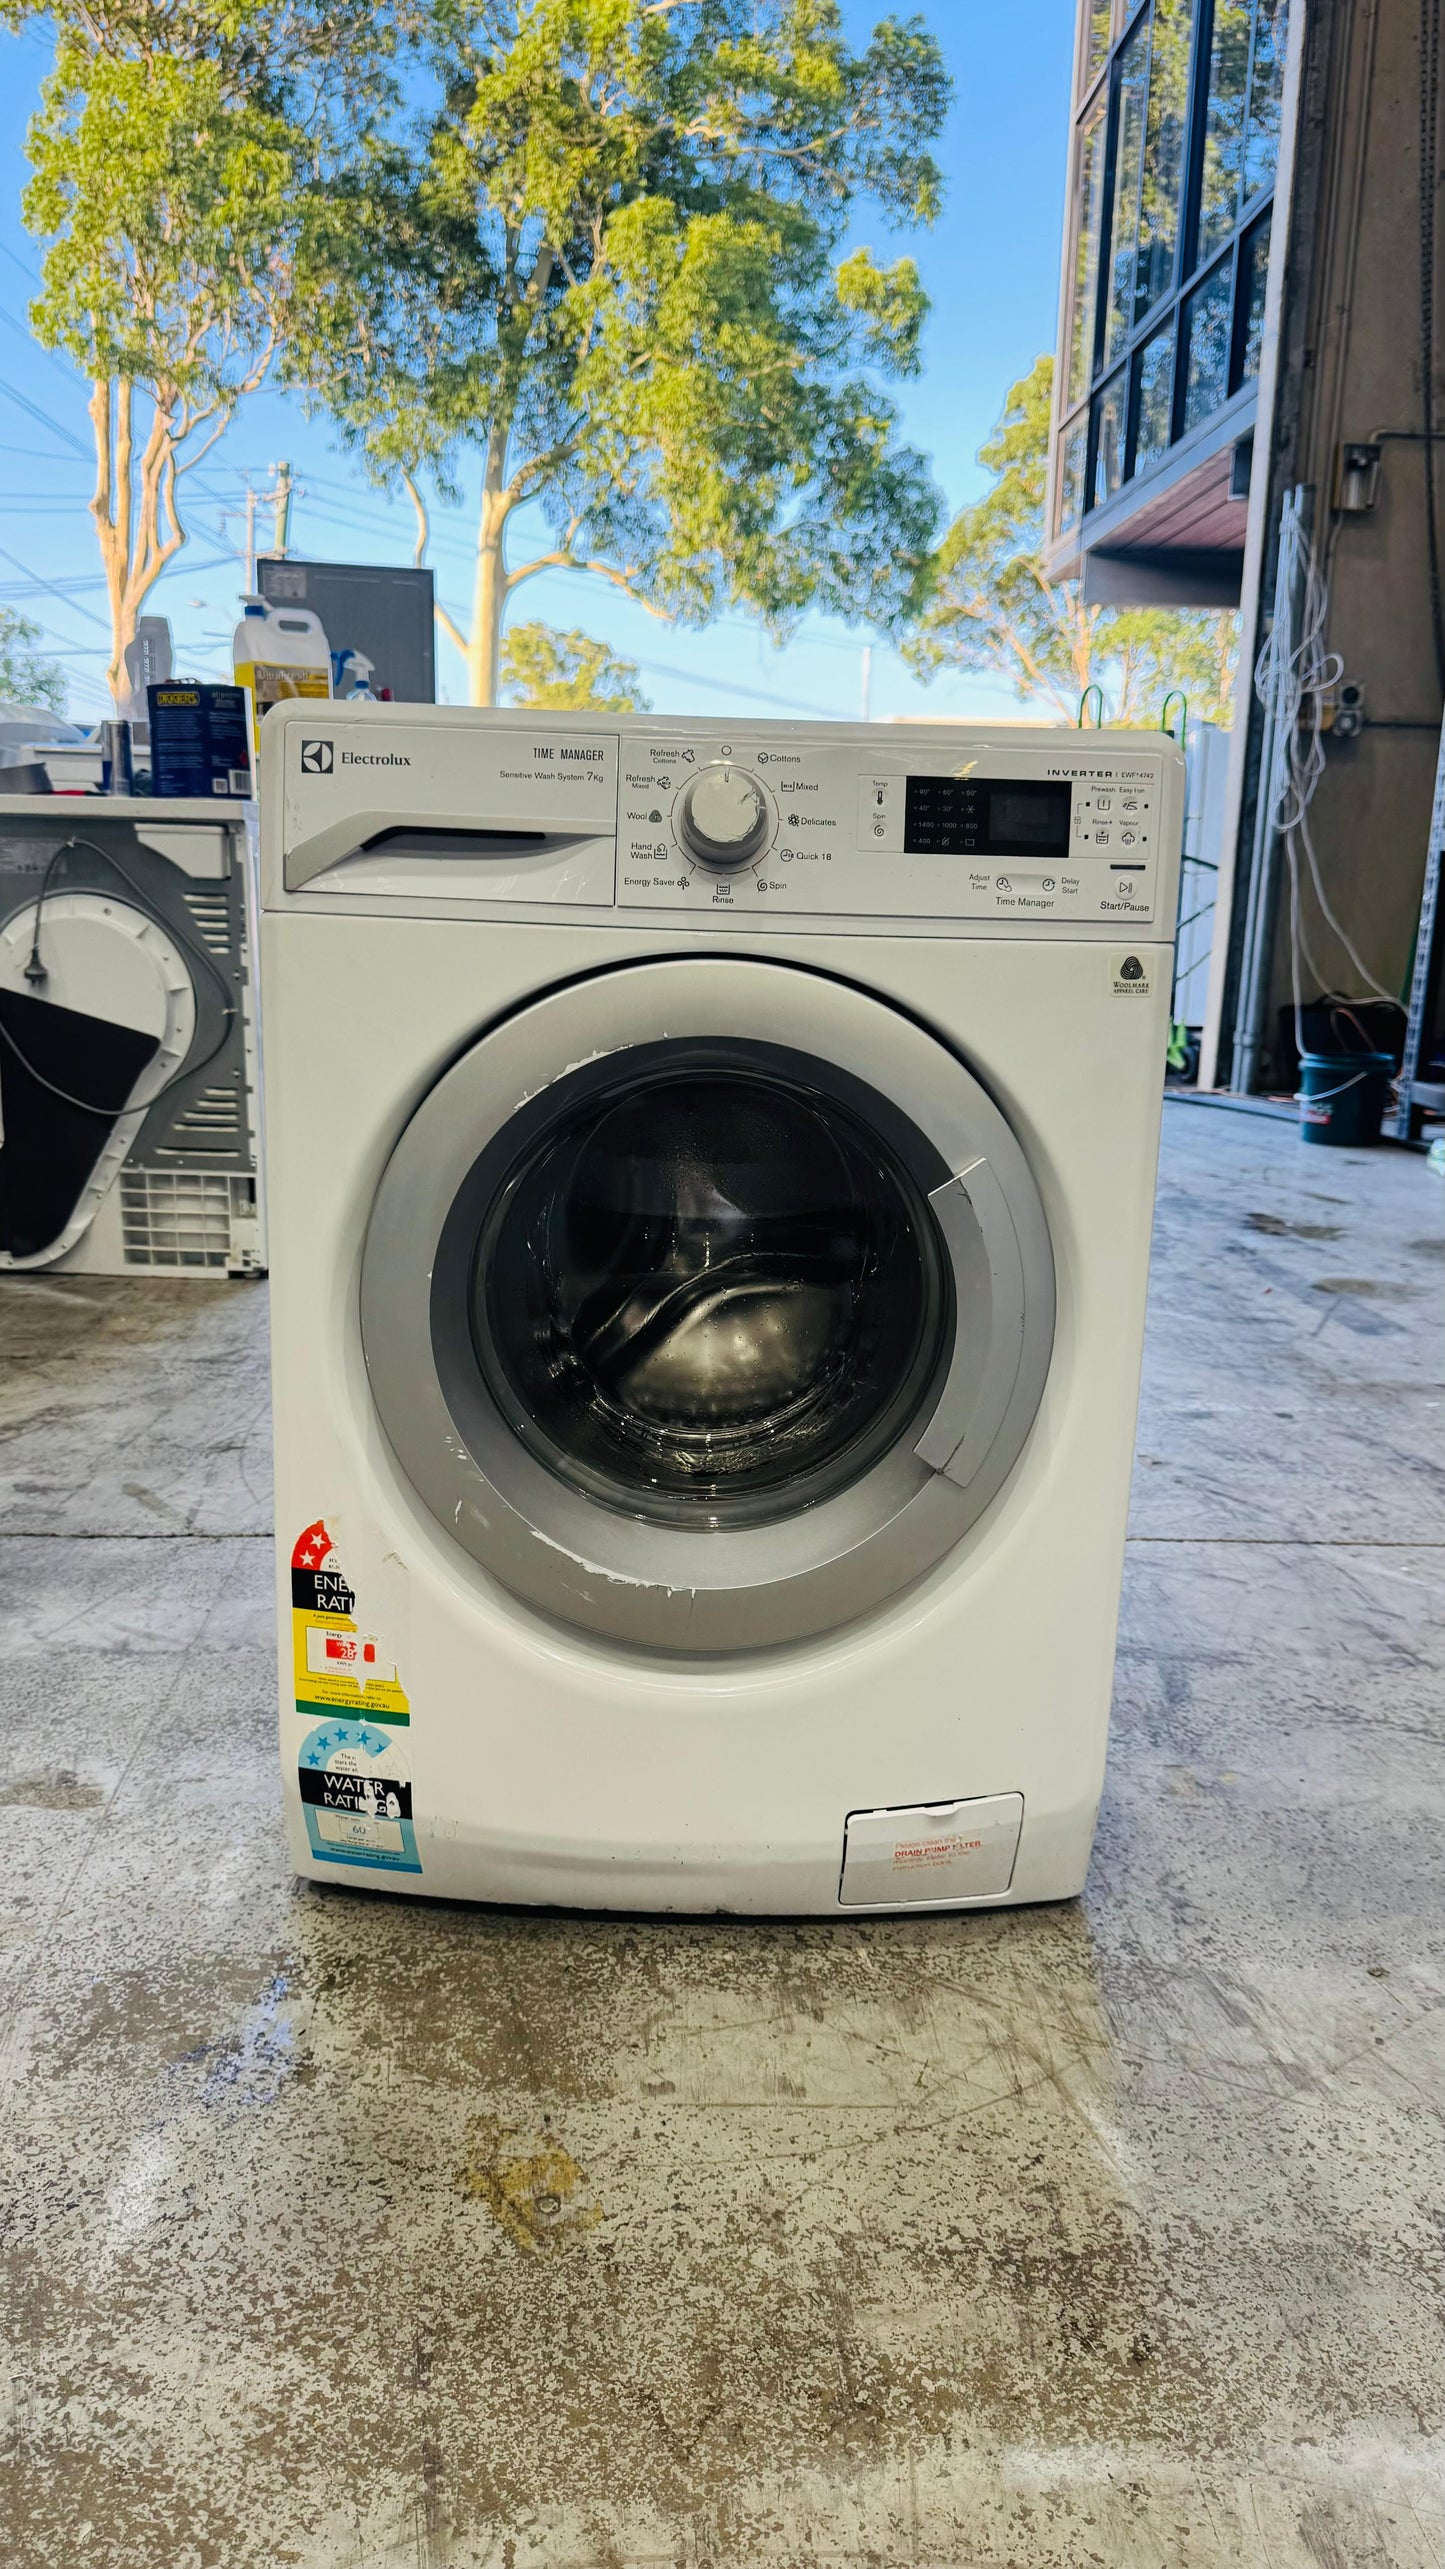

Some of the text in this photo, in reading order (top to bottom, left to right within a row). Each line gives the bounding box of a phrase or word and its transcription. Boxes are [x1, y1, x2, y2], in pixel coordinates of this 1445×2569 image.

[533, 748, 604, 761] TIME MANAGER
[650, 749, 679, 758] Refresh
[341, 752, 411, 767] Electrolux
[770, 754, 801, 763] Cottons
[500, 771, 603, 783] Sensitive Wash System 7Kg
[1047, 769, 1113, 778] INVERTER
[626, 774, 655, 783] Refresh
[796, 783, 818, 791] Mixed
[873, 781, 888, 789] Temp
[1119, 786, 1133, 794] Easy
[627, 812, 647, 820] Wool
[801, 817, 836, 826] Delicates
[631, 843, 652, 851] Hand
[630, 851, 653, 859] Wash
[796, 852, 832, 861] Quick 18
[624, 878, 675, 887] Energy Saver
[969, 873, 990, 883] Adjust
[1062, 877, 1080, 886] Delay
[769, 882, 787, 890] Spin
[712, 896, 734, 904] Rinse
[996, 897, 1055, 909] Time Manager
[1100, 901, 1149, 912] Start/Pause
[315, 1575, 352, 1593] ENE
[324, 1792, 386, 1813] RATIG
[895, 1849, 922, 1857] DRAIN
[953, 1840, 981, 1850] FLTER
